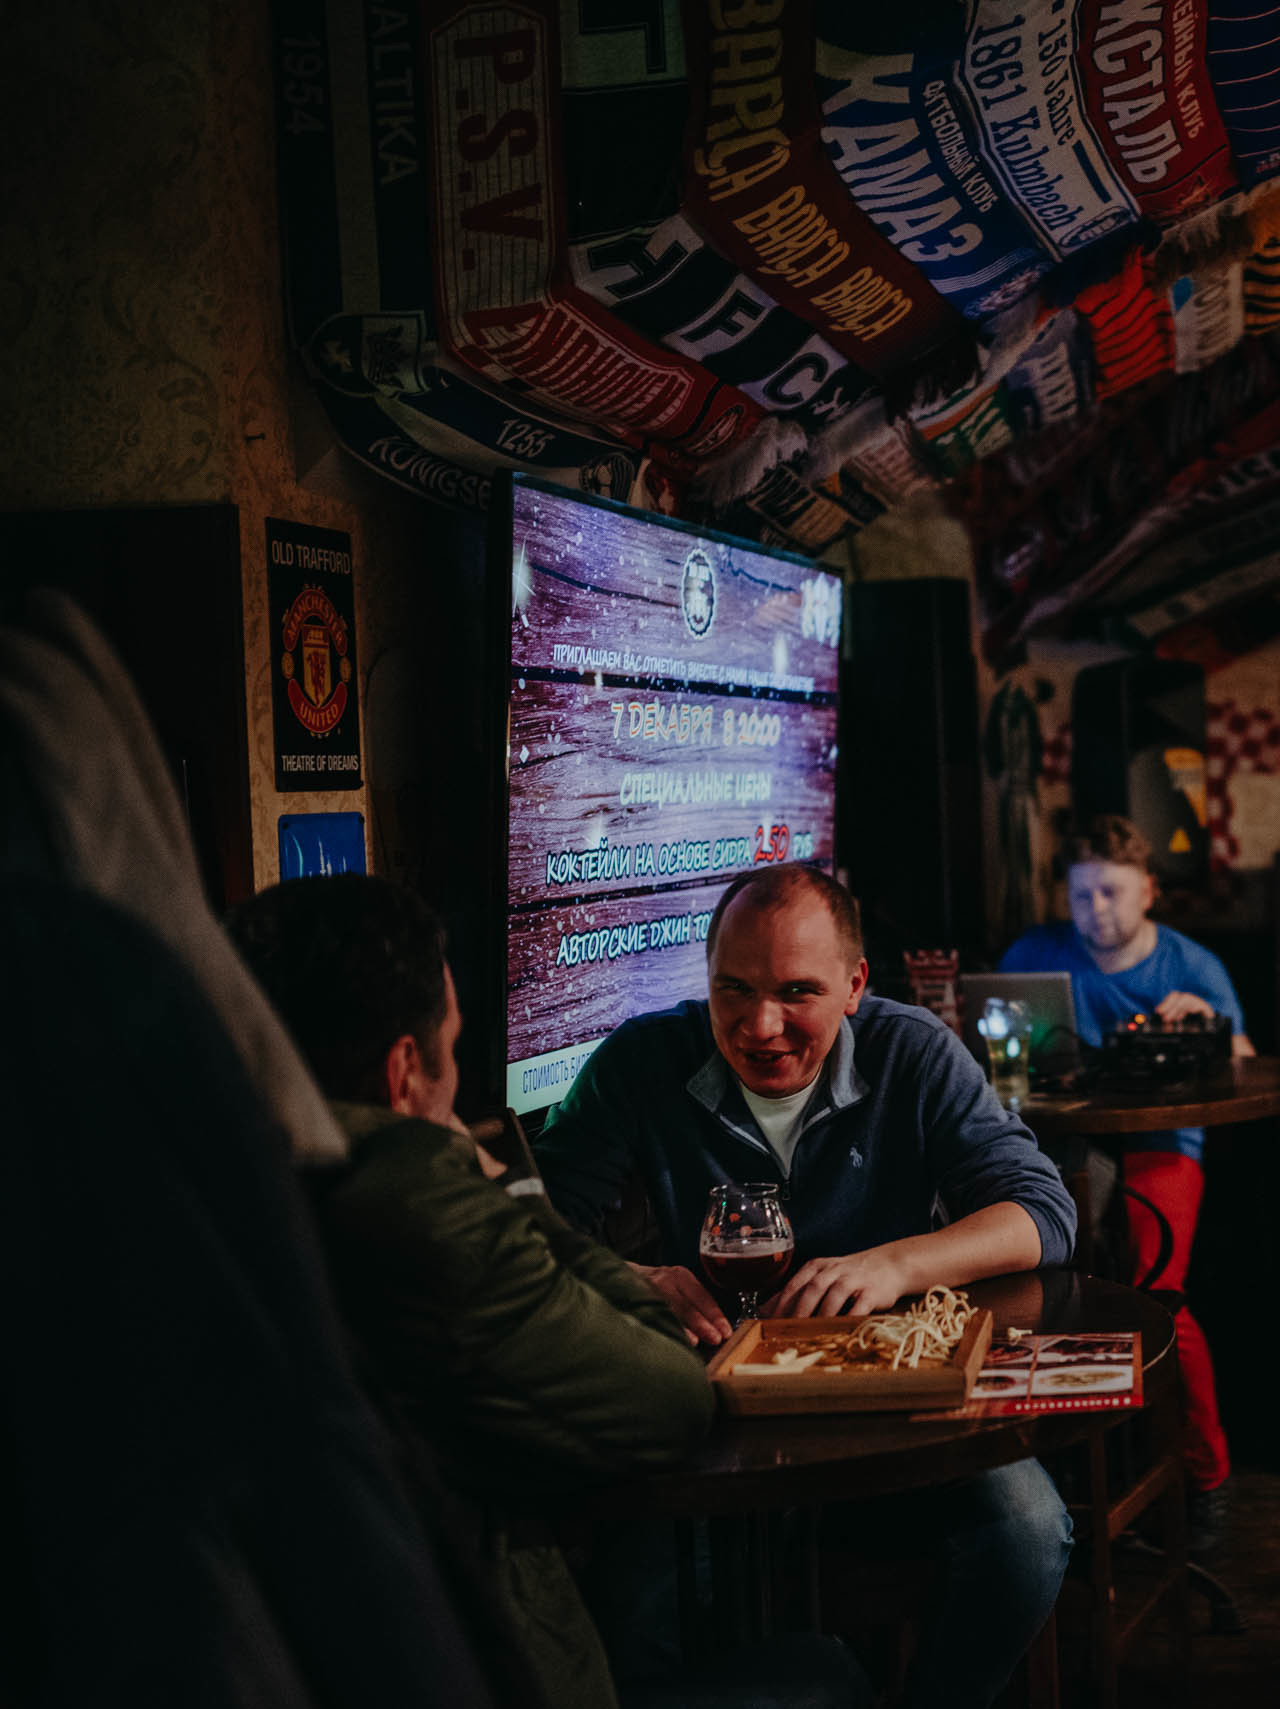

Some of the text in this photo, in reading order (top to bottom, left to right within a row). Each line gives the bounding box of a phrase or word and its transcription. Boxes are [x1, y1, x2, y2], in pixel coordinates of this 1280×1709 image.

[1039, 18, 1067, 78] 150
[278, 36, 328, 137] 1954
[970, 13, 1084, 231] 1861 Kulmbach
[462, 298, 694, 432] EINDHOVEN
[496, 417, 558, 460] 1255
[271, 539, 352, 575] OLD TRAFFORD
[553, 643, 621, 669] ПРИГЛАШАЕМ
[623, 652, 643, 672] ВАС
[299, 702, 340, 729] UNITED
[611, 702, 625, 739] 7
[281, 753, 359, 773] THEATRE OF DREAMS
[546, 836, 631, 887] КОКТЕЙЛИ
[634, 843, 656, 878] НА
[657, 839, 710, 876] ОСНОВЕ
[555, 922, 649, 967] АВТОРСКИЕ
[523, 1061, 568, 1094] СТОИМОСТЬ
